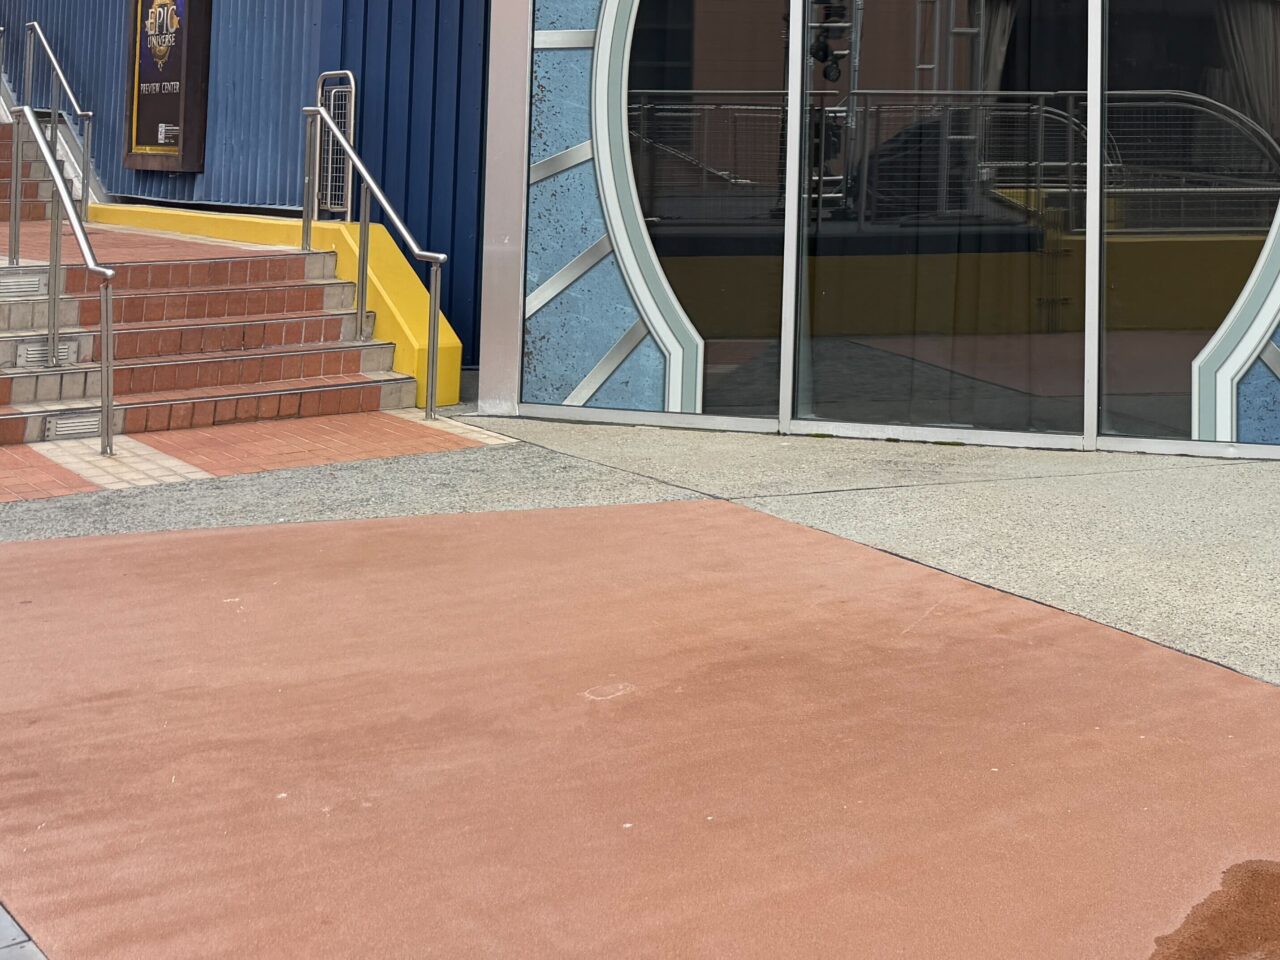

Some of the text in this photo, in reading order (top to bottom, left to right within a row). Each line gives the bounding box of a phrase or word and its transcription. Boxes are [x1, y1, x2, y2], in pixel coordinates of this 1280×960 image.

[148, 5, 177, 36] EPIC
[147, 33, 176, 48] UNIVERSE
[140, 81, 180, 95] PREVIEW CENTER
